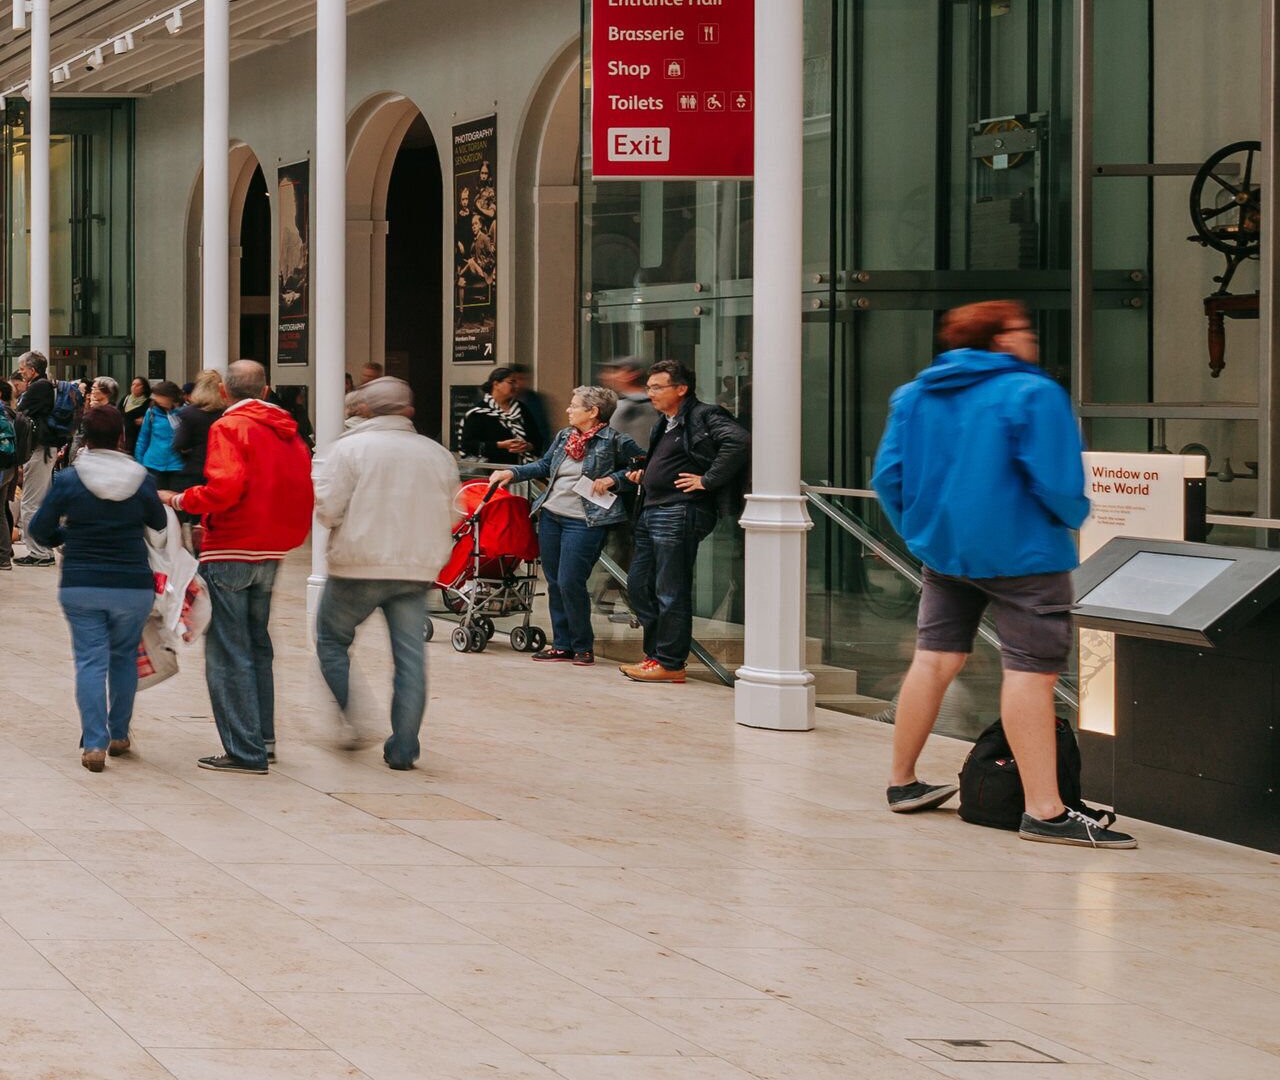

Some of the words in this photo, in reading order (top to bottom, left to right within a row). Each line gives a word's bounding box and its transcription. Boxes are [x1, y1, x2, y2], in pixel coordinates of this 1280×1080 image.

[608, 25, 685, 41] Brasserie
[607, 60, 651, 80] Shop
[607, 94, 664, 110] Toilets
[454, 127, 494, 145] PHOTOGRAPHY
[614, 134, 663, 156] Exit
[1092, 466, 1141, 480] Window
[1143, 471, 1159, 481] on
[1092, 481, 1111, 494] the
[1113, 482, 1150, 496] World
